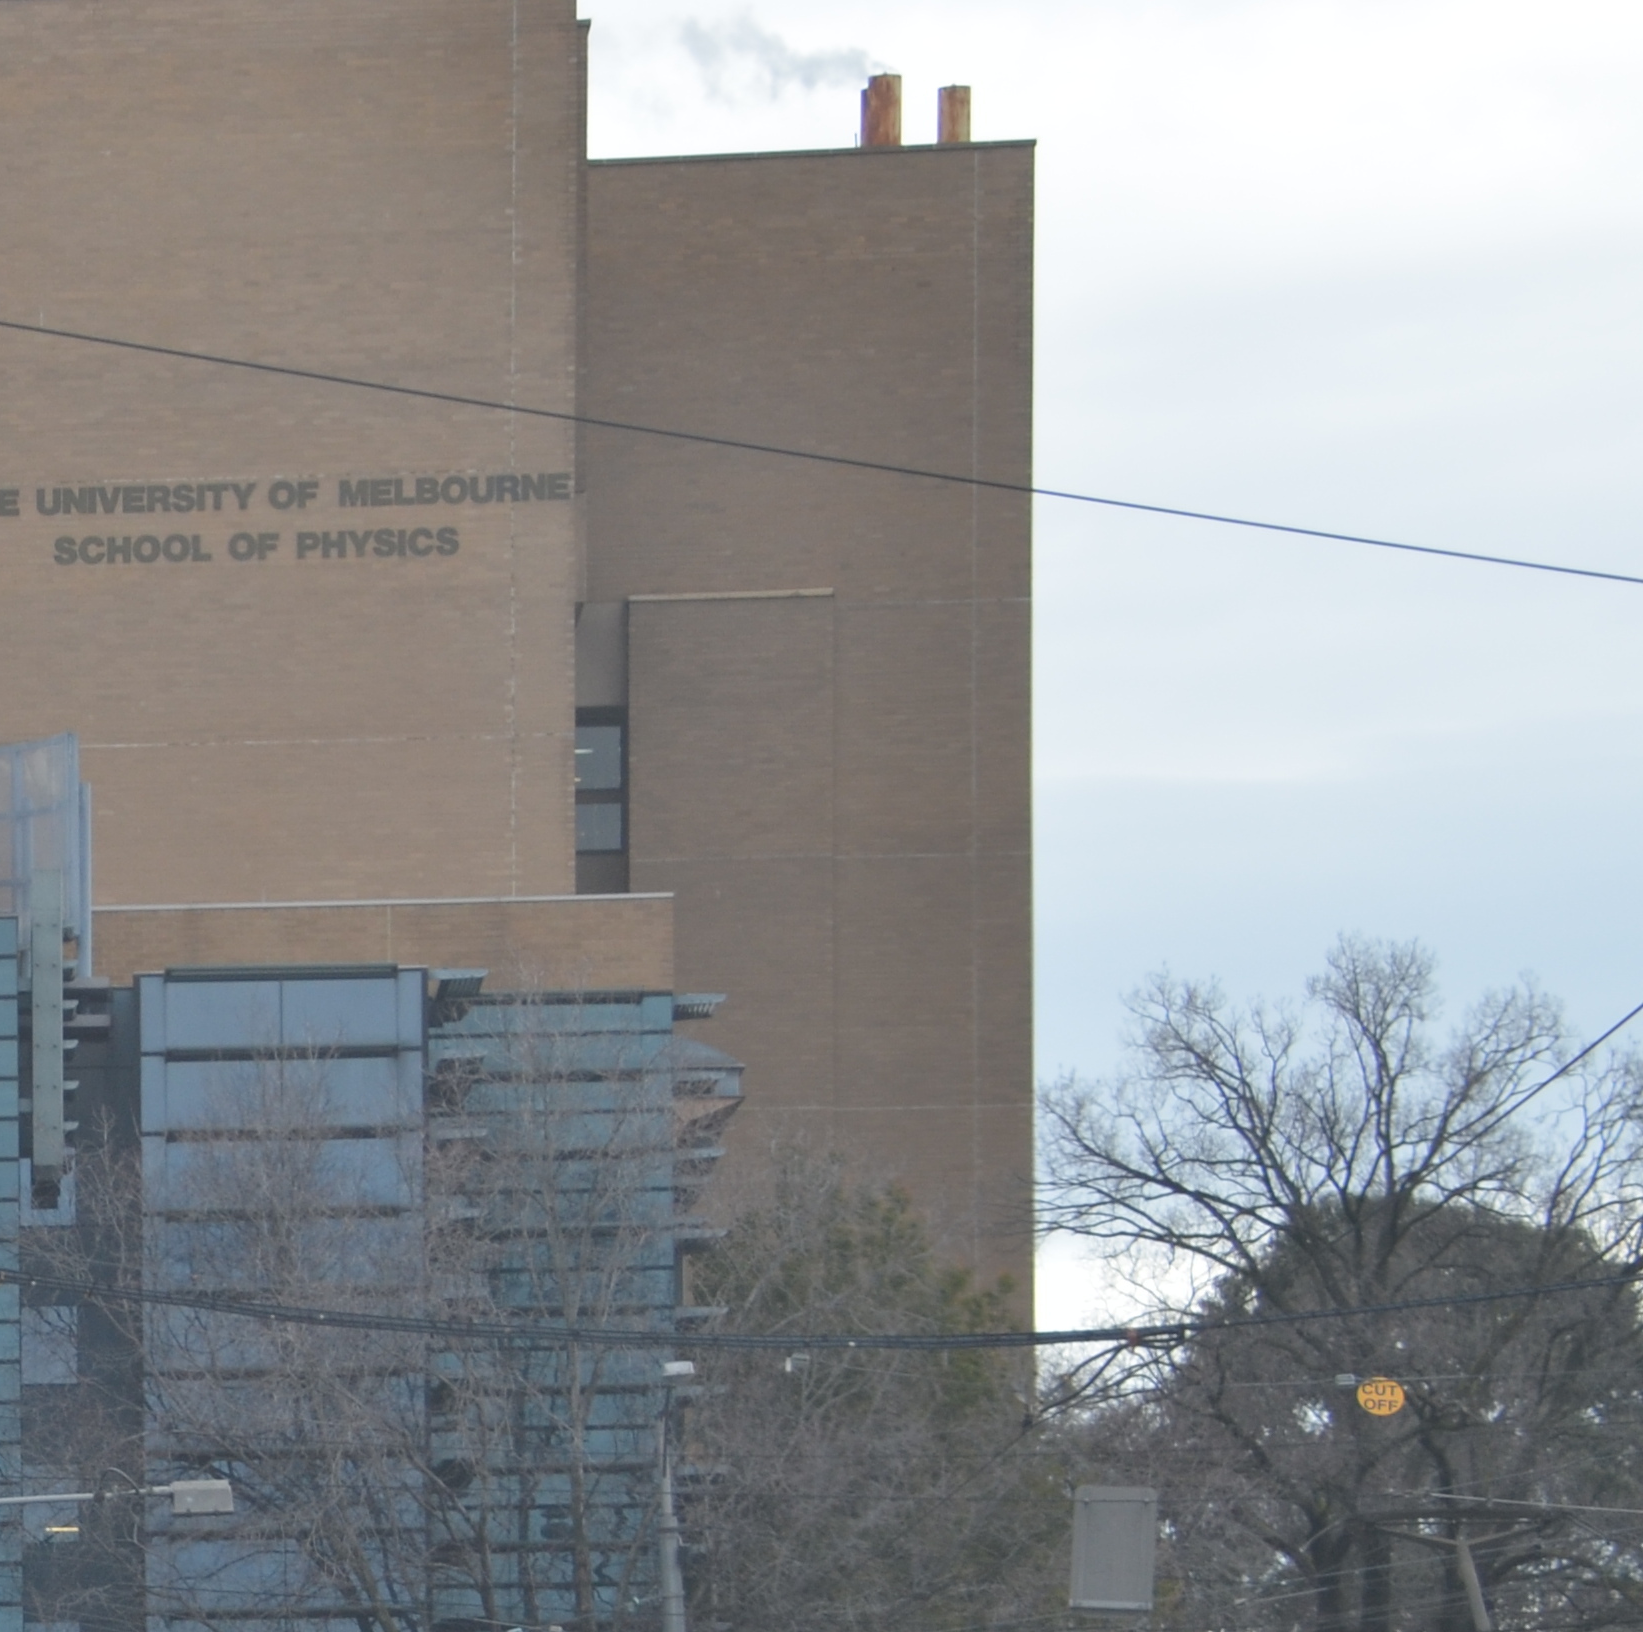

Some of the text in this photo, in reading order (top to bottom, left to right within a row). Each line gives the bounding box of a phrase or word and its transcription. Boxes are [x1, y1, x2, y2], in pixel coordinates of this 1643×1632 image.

[36, 482, 257, 516] UNIVERSITY
[267, 480, 319, 510] OF
[337, 472, 572, 507] MELBOURNE
[53, 526, 460, 565] SCHOOL OF PHYSICS
